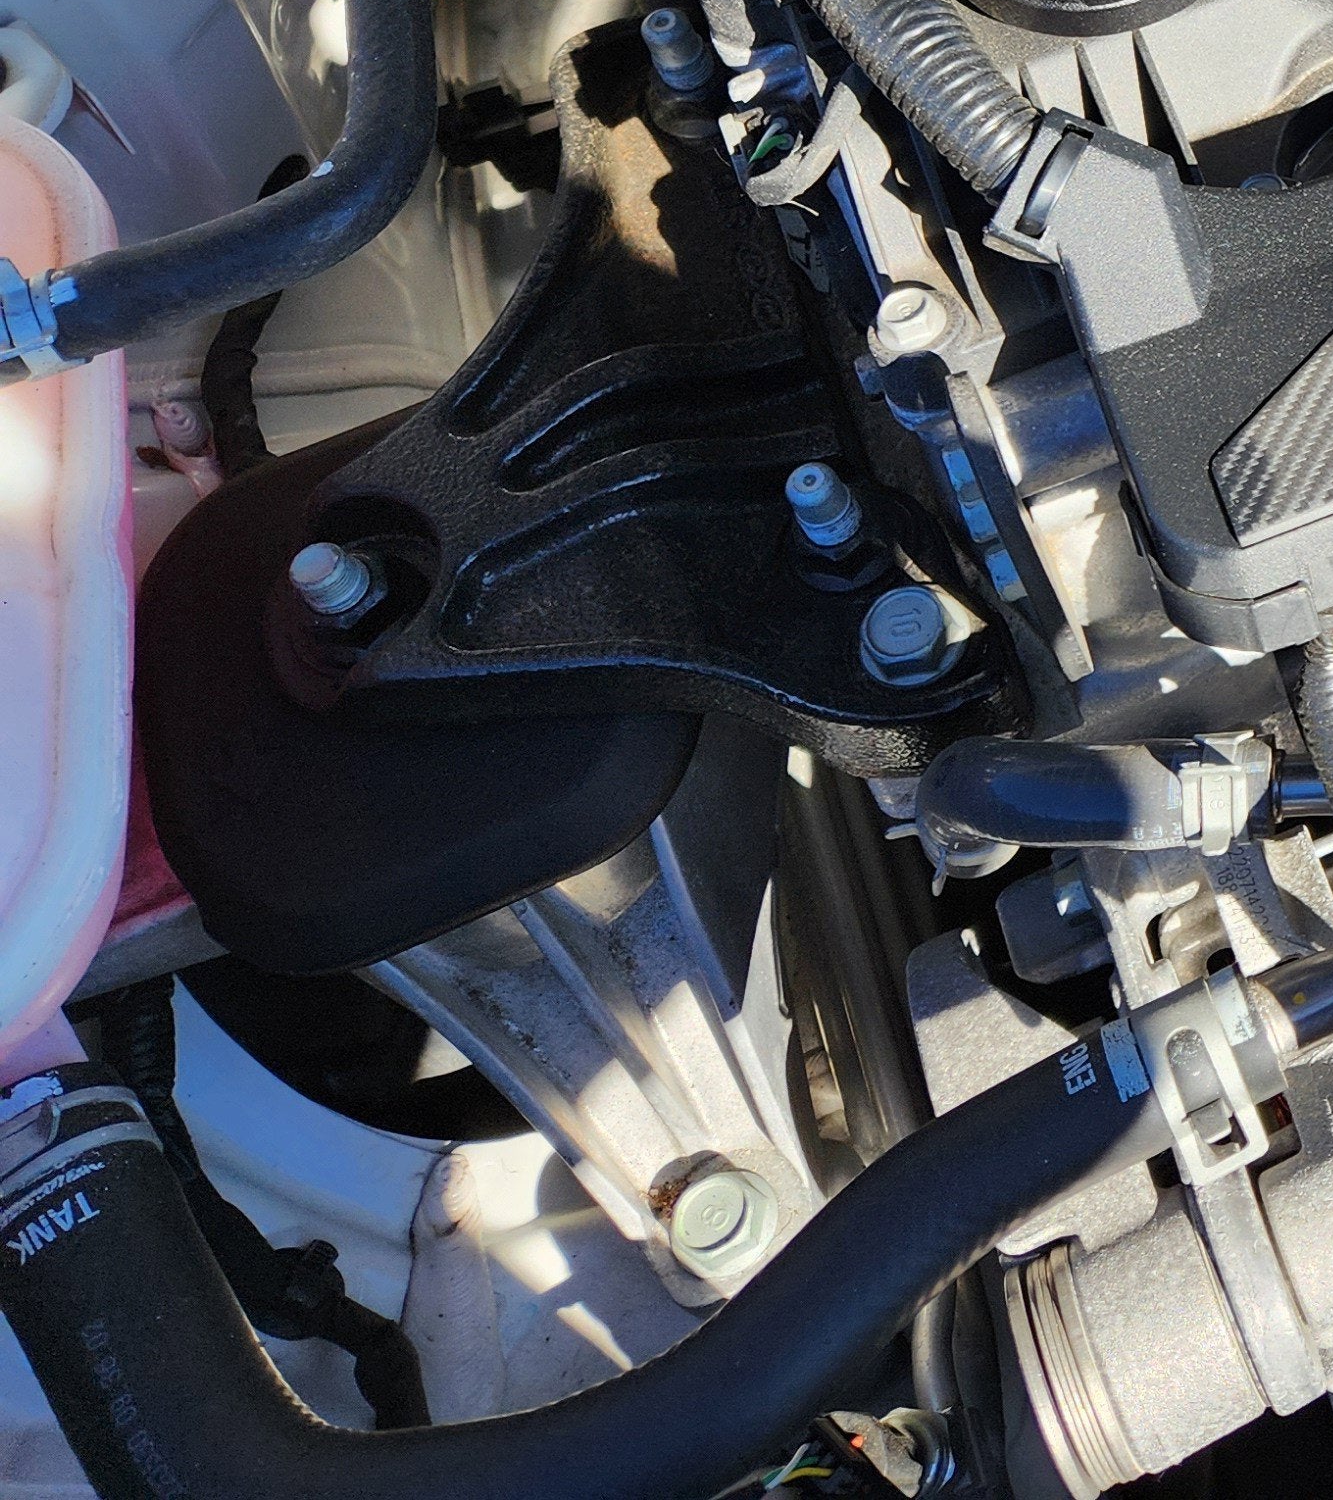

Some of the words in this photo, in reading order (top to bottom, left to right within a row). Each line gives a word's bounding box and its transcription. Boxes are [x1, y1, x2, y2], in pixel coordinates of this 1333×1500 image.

[888, 607, 921, 638] 10
[1060, 1042, 1097, 1095] ENG
[6, 1192, 101, 1266] TANK
[700, 1204, 730, 1231] 8
